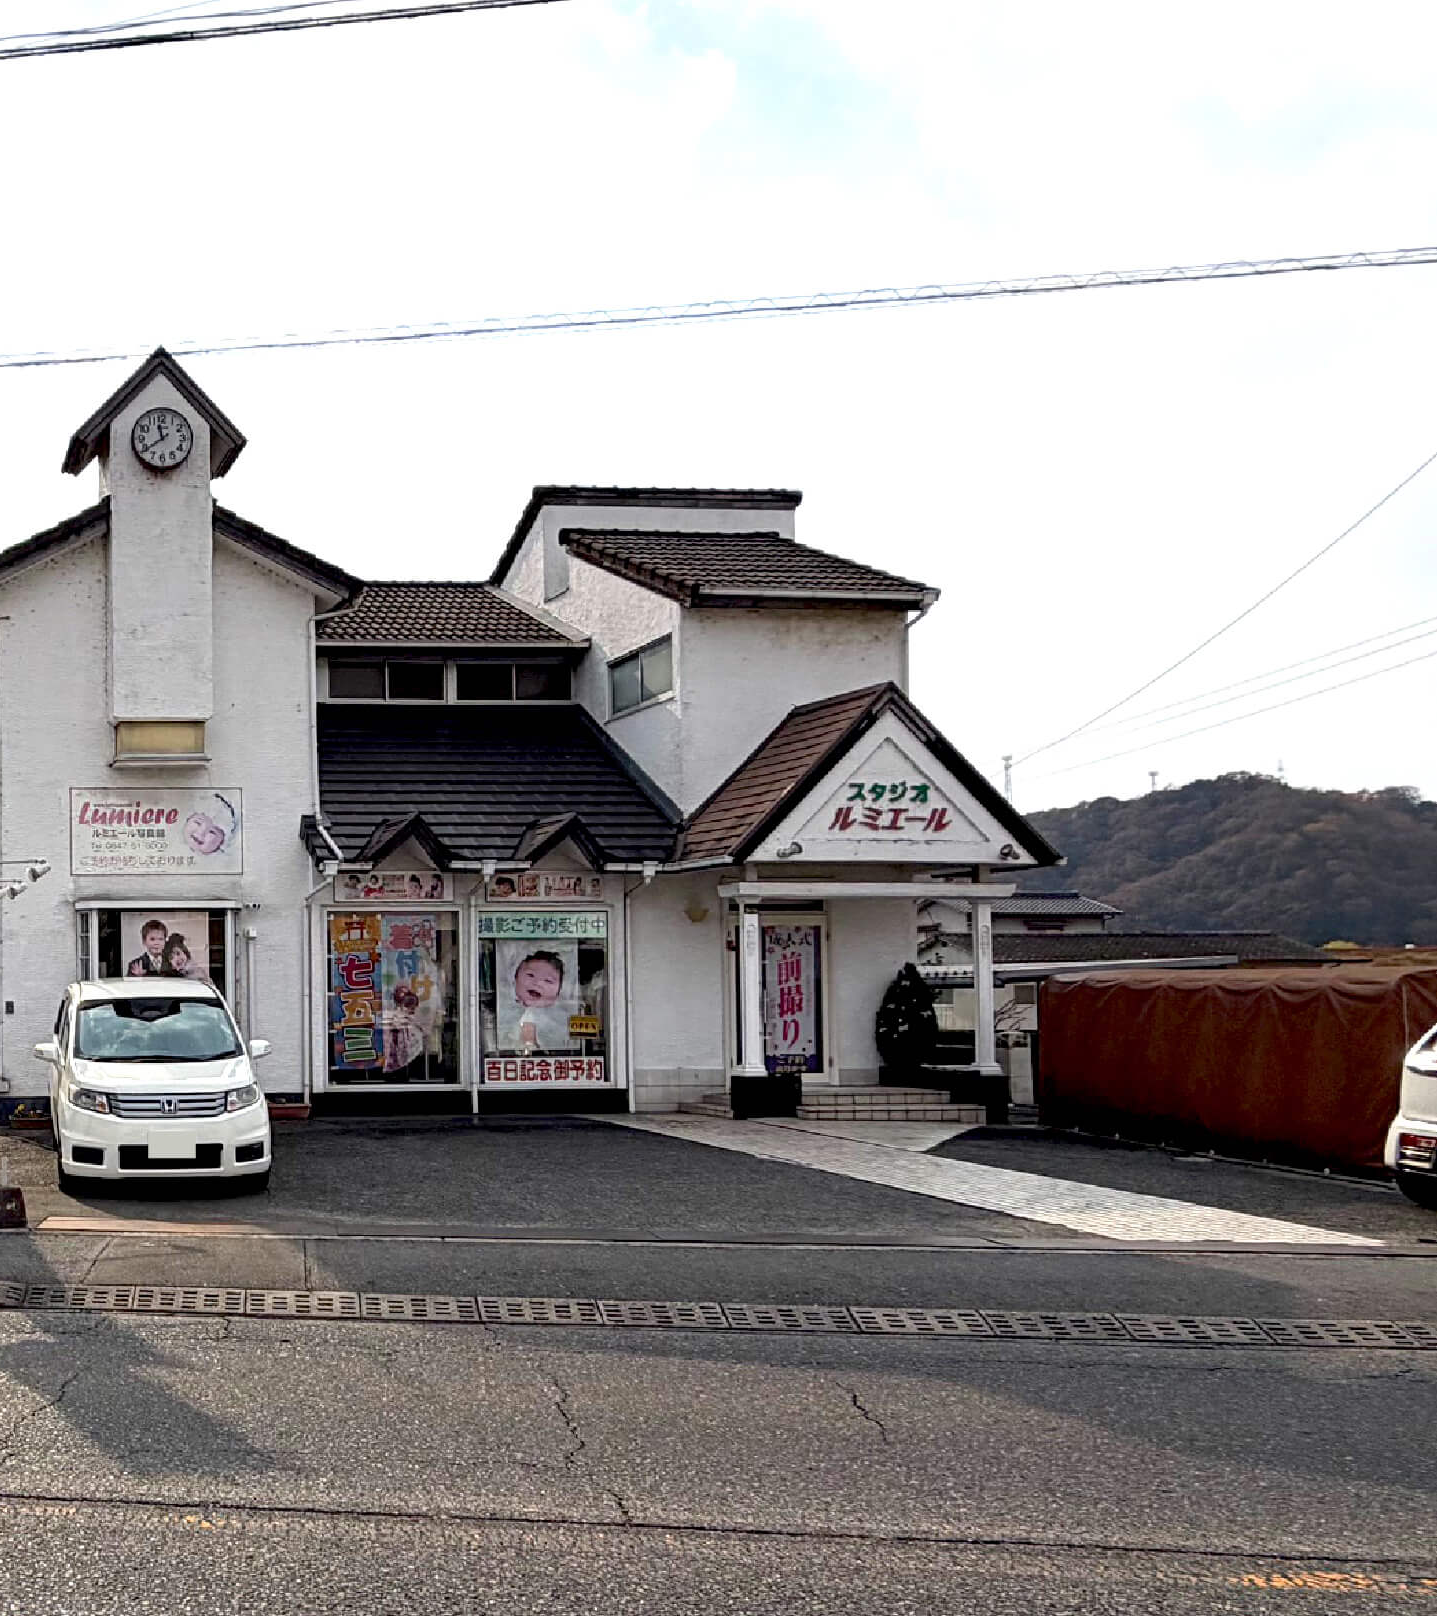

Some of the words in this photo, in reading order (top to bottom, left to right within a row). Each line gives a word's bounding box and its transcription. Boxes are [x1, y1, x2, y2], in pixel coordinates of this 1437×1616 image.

[847, 780, 931, 803] スタジオ
[828, 806, 953, 833] ルミエール
[339, 954, 376, 1062] 七五三
[777, 951, 804, 1049] 前撮り
[486, 1060, 604, 1081] 百日記念御予約
